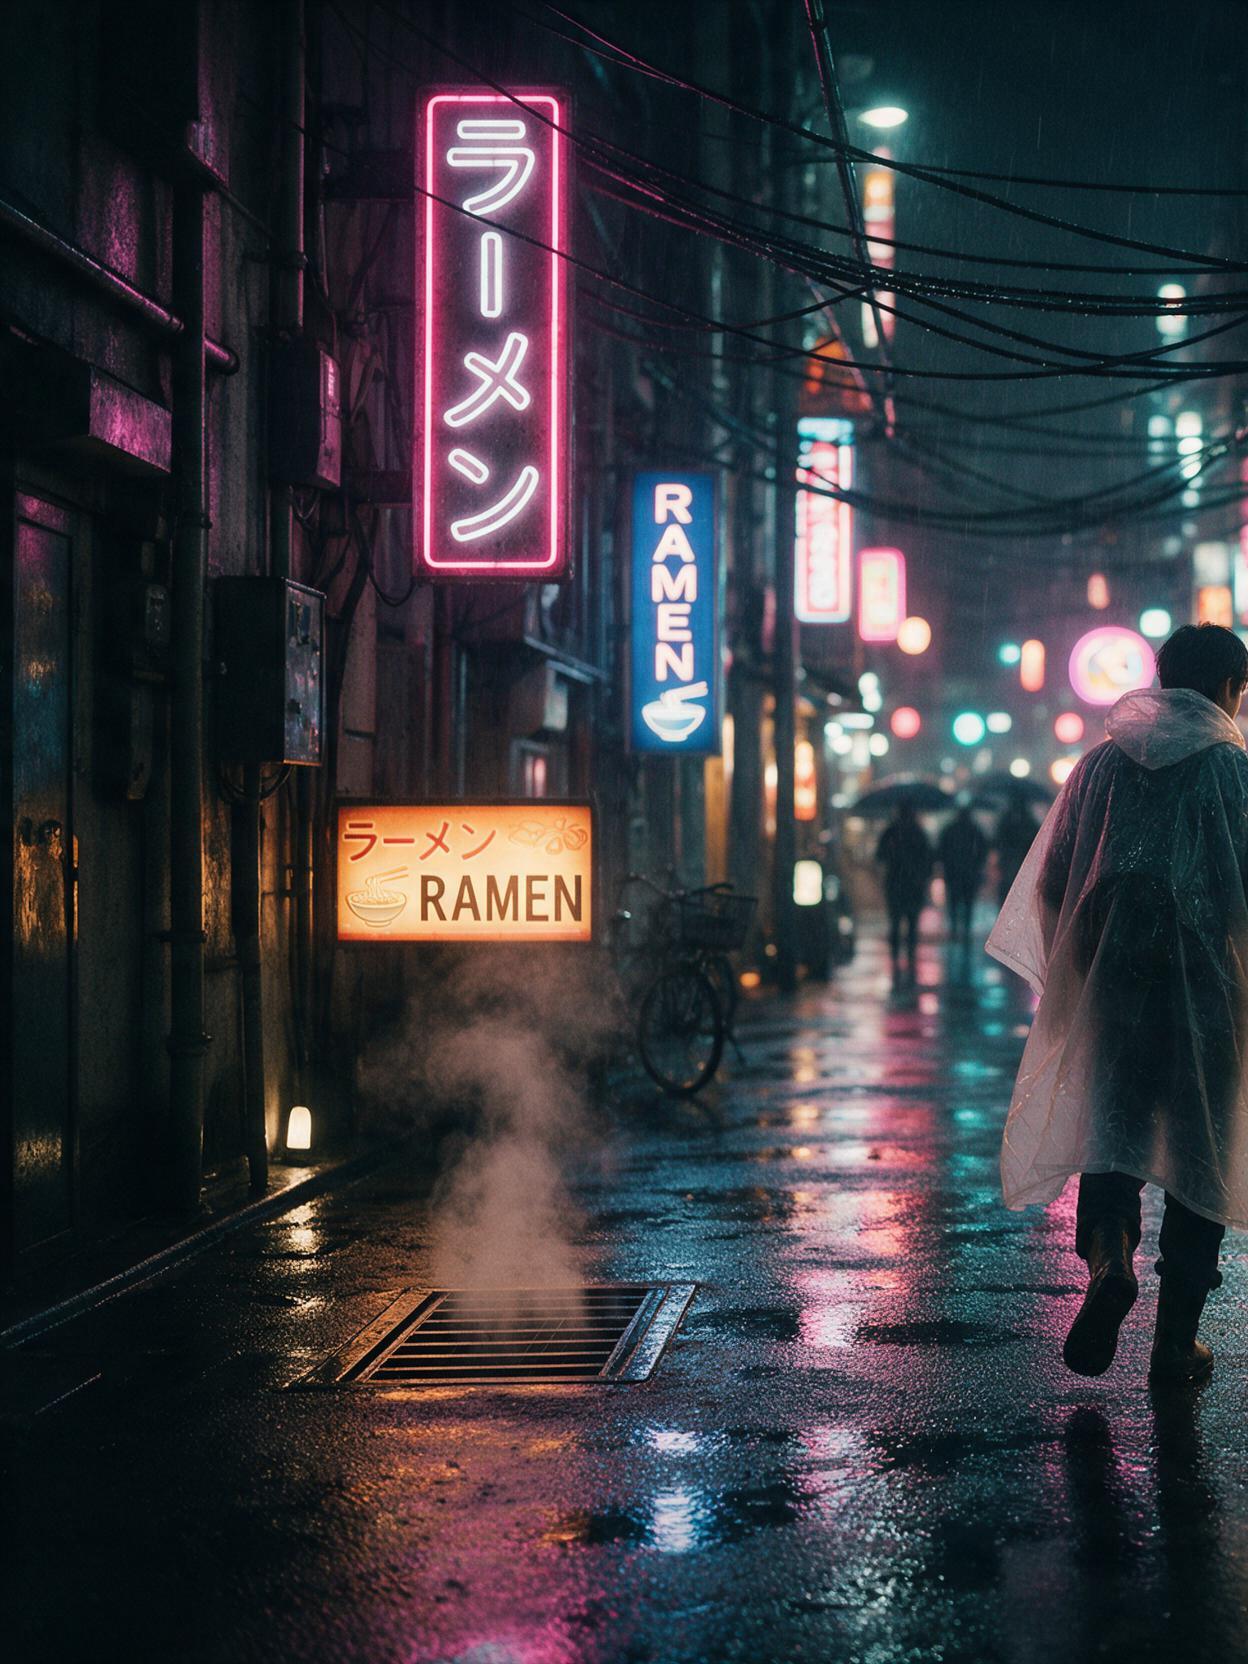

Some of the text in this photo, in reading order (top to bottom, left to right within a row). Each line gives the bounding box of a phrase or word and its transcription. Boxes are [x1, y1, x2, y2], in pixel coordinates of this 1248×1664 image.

[444, 119, 540, 543] ラーメン
[649, 482, 697, 682] RAMEN
[342, 820, 498, 863] ラーメン
[420, 874, 583, 923] RAMEN
